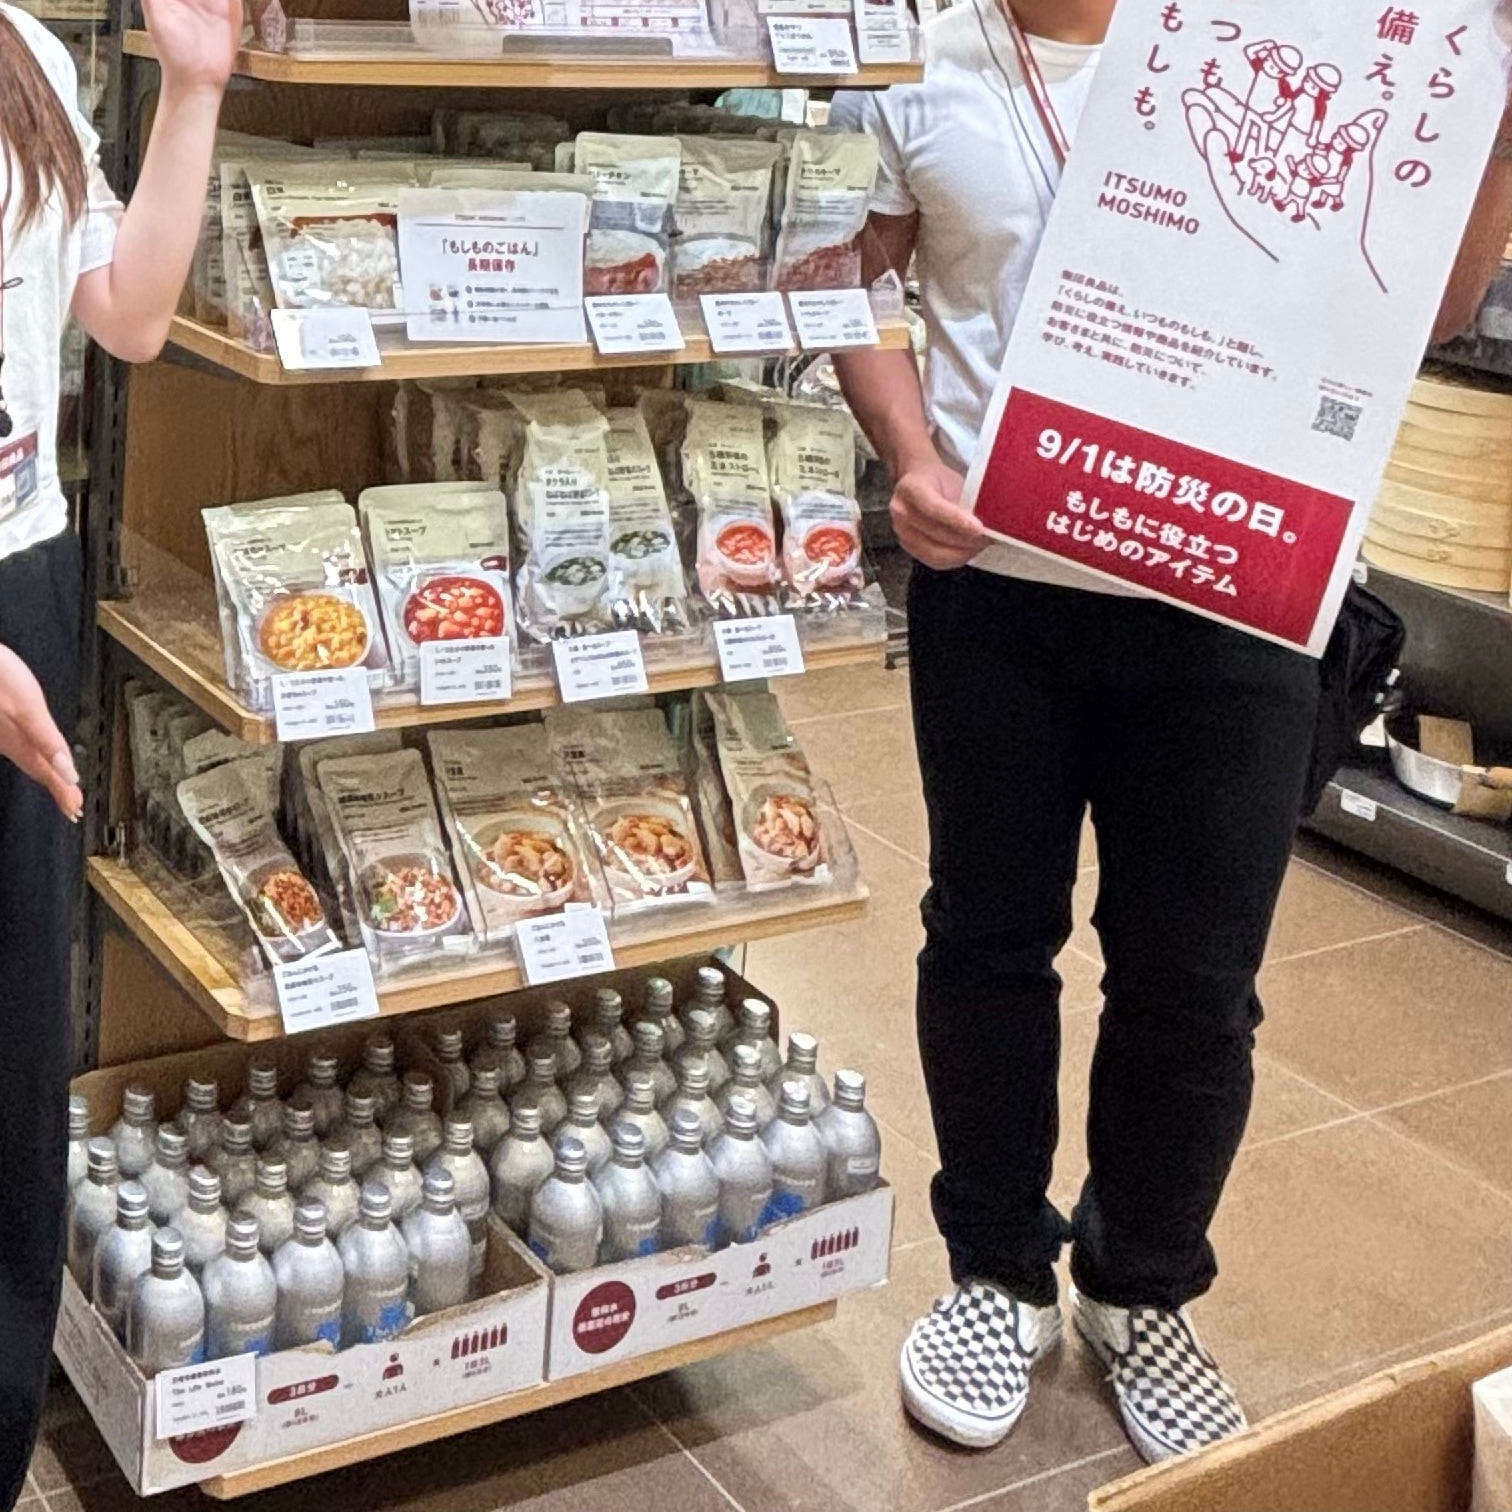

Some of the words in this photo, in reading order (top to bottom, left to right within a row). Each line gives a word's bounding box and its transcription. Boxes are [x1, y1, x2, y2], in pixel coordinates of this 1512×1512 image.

[1365, 6, 1419, 101] 備え。
[1394, 25, 1468, 188] くらしの
[1097, 192, 1200, 235] MOSHIMO
[1104, 171, 1187, 207] ITSUMO
[1036, 428, 1298, 545] 9/1は防災の日。
[1066, 490, 1239, 565] もしもに役立つ
[1046, 510, 1237, 597] はじめのアイテム
